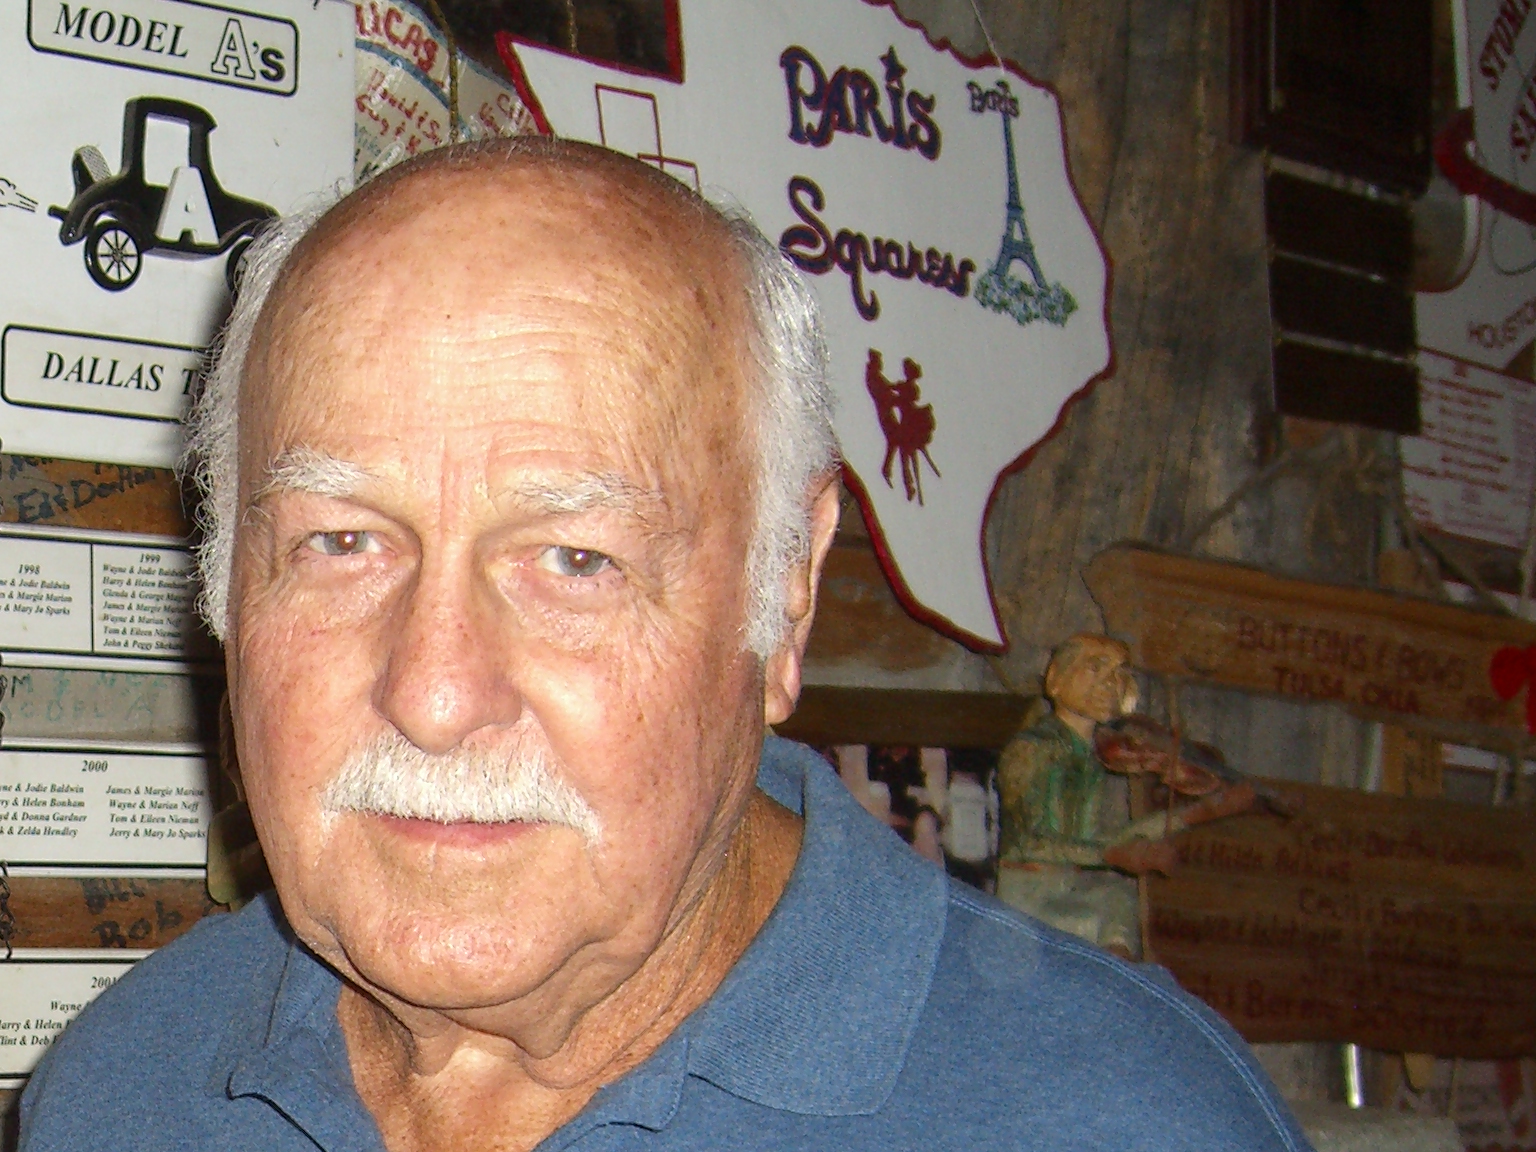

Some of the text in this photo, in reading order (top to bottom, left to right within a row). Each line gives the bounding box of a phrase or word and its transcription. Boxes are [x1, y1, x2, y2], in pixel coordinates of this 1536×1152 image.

[53, 3, 189, 59] MODEL
[42, 351, 164, 393] DALLAS
[82, 760, 108, 772] 2000
[22, 797, 47, 807] Helen
[50, 798, 85, 807] Bonham
[21, 812, 50, 821] Donna
[52, 813, 87, 821] Gardner
[17, 826, 41, 835] Zelda
[43, 826, 78, 838] Hendley
